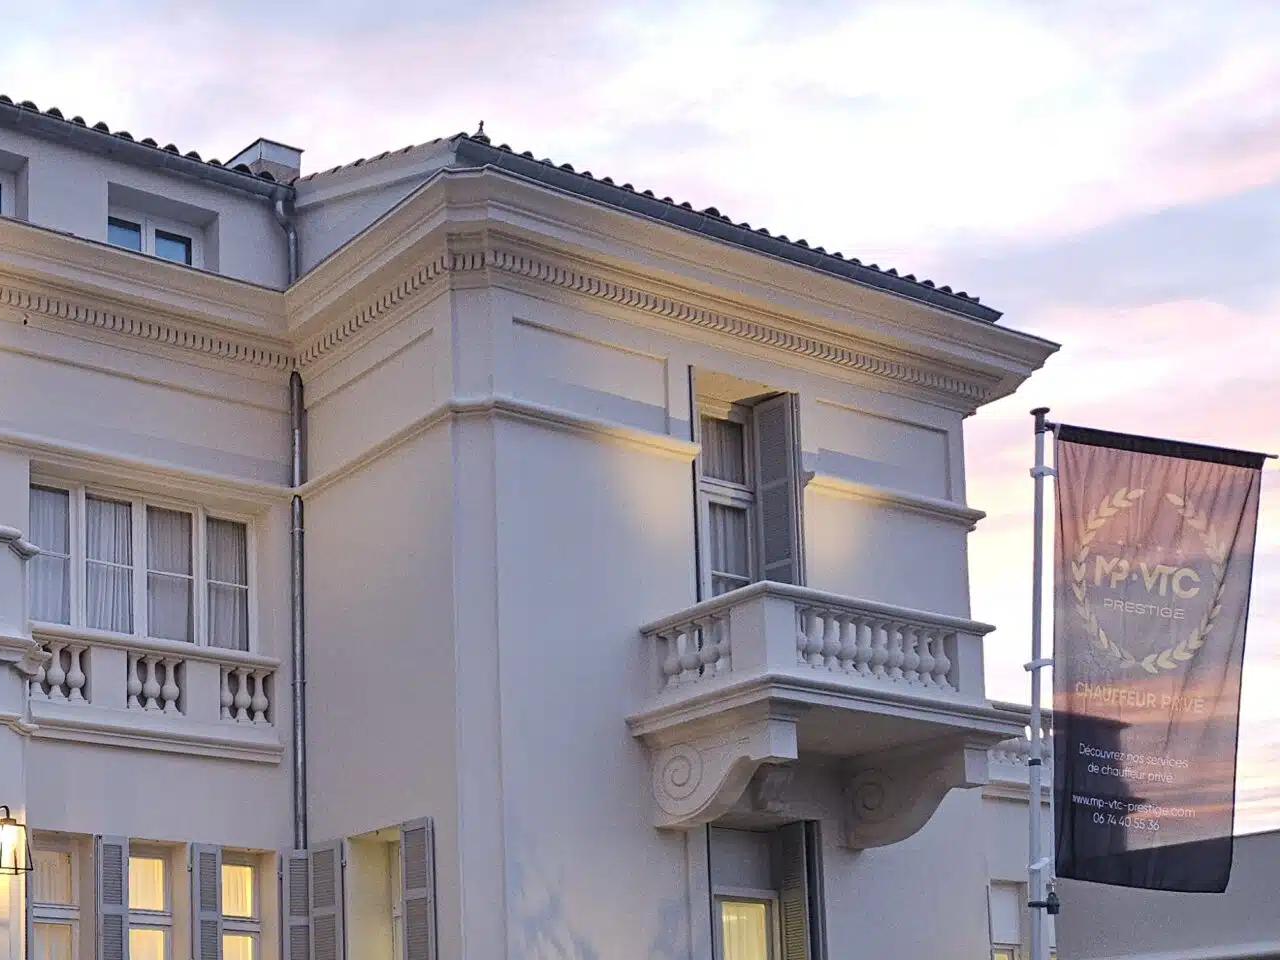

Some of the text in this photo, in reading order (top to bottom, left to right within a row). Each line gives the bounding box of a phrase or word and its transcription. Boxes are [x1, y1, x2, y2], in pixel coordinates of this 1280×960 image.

[1103, 598, 1185, 621] PRESTIGE
[1075, 681, 1157, 709] CHAUFFEUR
[1079, 743, 1189, 769] Découvrez nos services
[1087, 763, 1100, 774] de
[1101, 764, 1146, 780] chauffeur
[1093, 812, 1160, 832] 06 74 40 55 36
